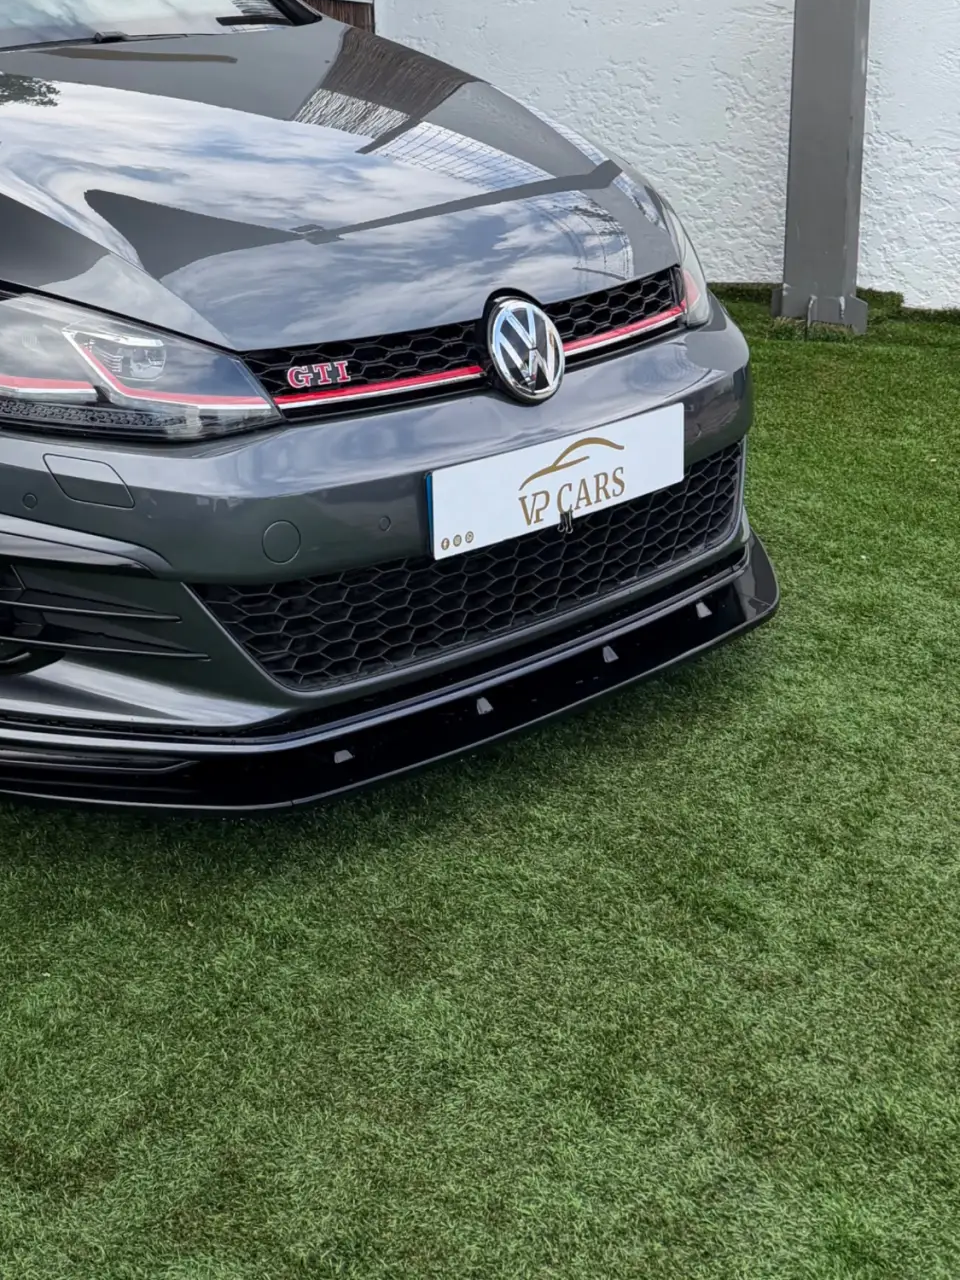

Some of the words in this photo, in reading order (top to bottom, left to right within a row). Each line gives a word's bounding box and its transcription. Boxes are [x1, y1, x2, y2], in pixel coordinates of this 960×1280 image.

[287, 360, 351, 389] GTI
[518, 490, 550, 526] VP
[556, 466, 625, 516] CARS
